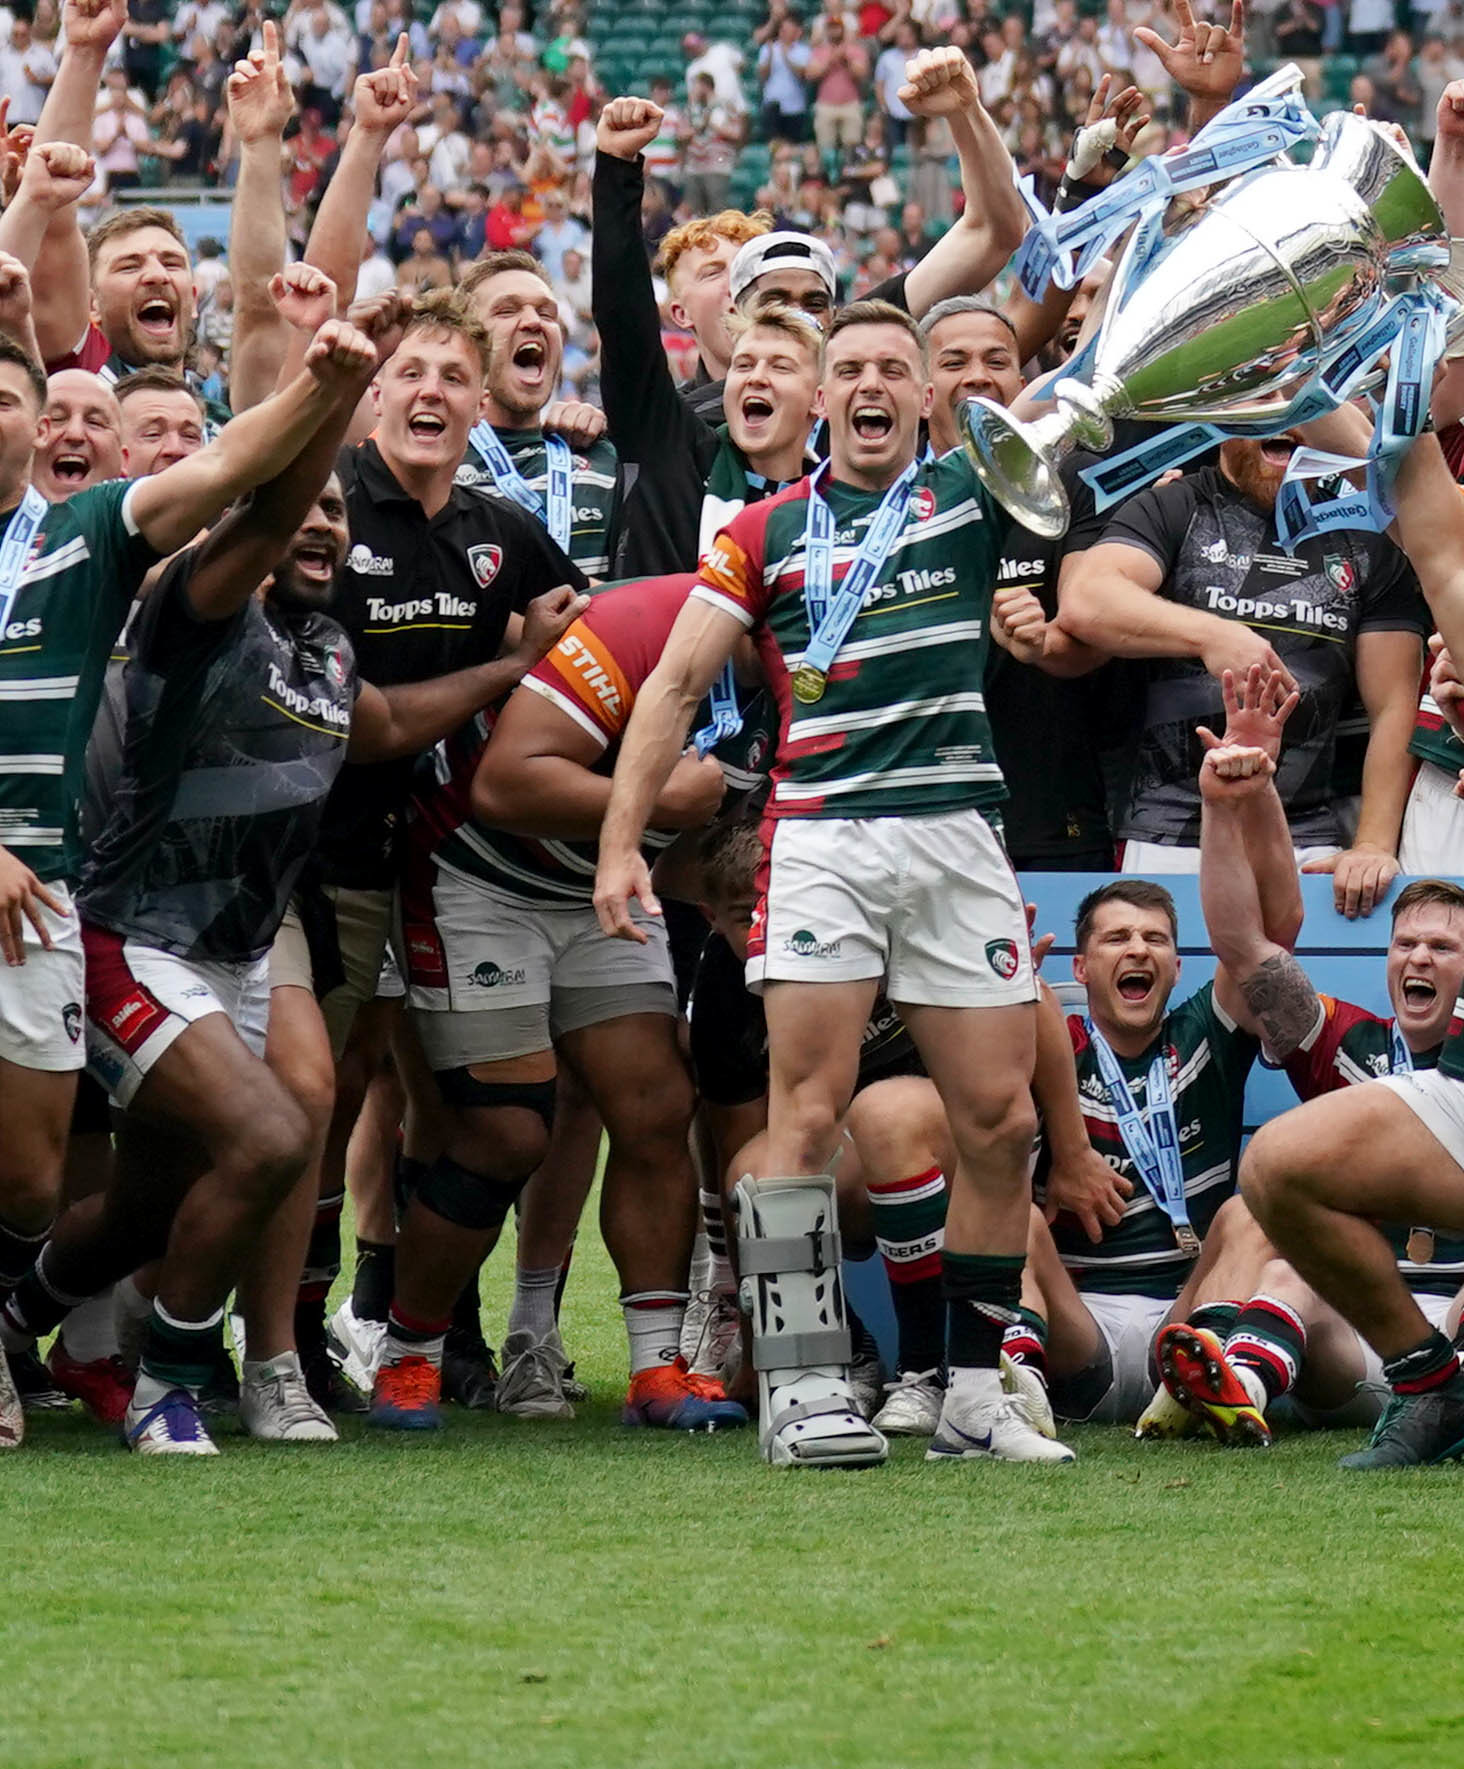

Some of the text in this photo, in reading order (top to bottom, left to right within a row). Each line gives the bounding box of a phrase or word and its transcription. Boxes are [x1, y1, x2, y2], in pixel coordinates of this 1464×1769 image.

[895, 566, 957, 593] Tiles
[366, 592, 477, 624] Topps Tiles
[1205, 585, 1349, 631] Topps Tiles
[266, 662, 320, 718] Topps
[556, 635, 622, 717] STIHL
[881, 1237, 937, 1258] GERS
